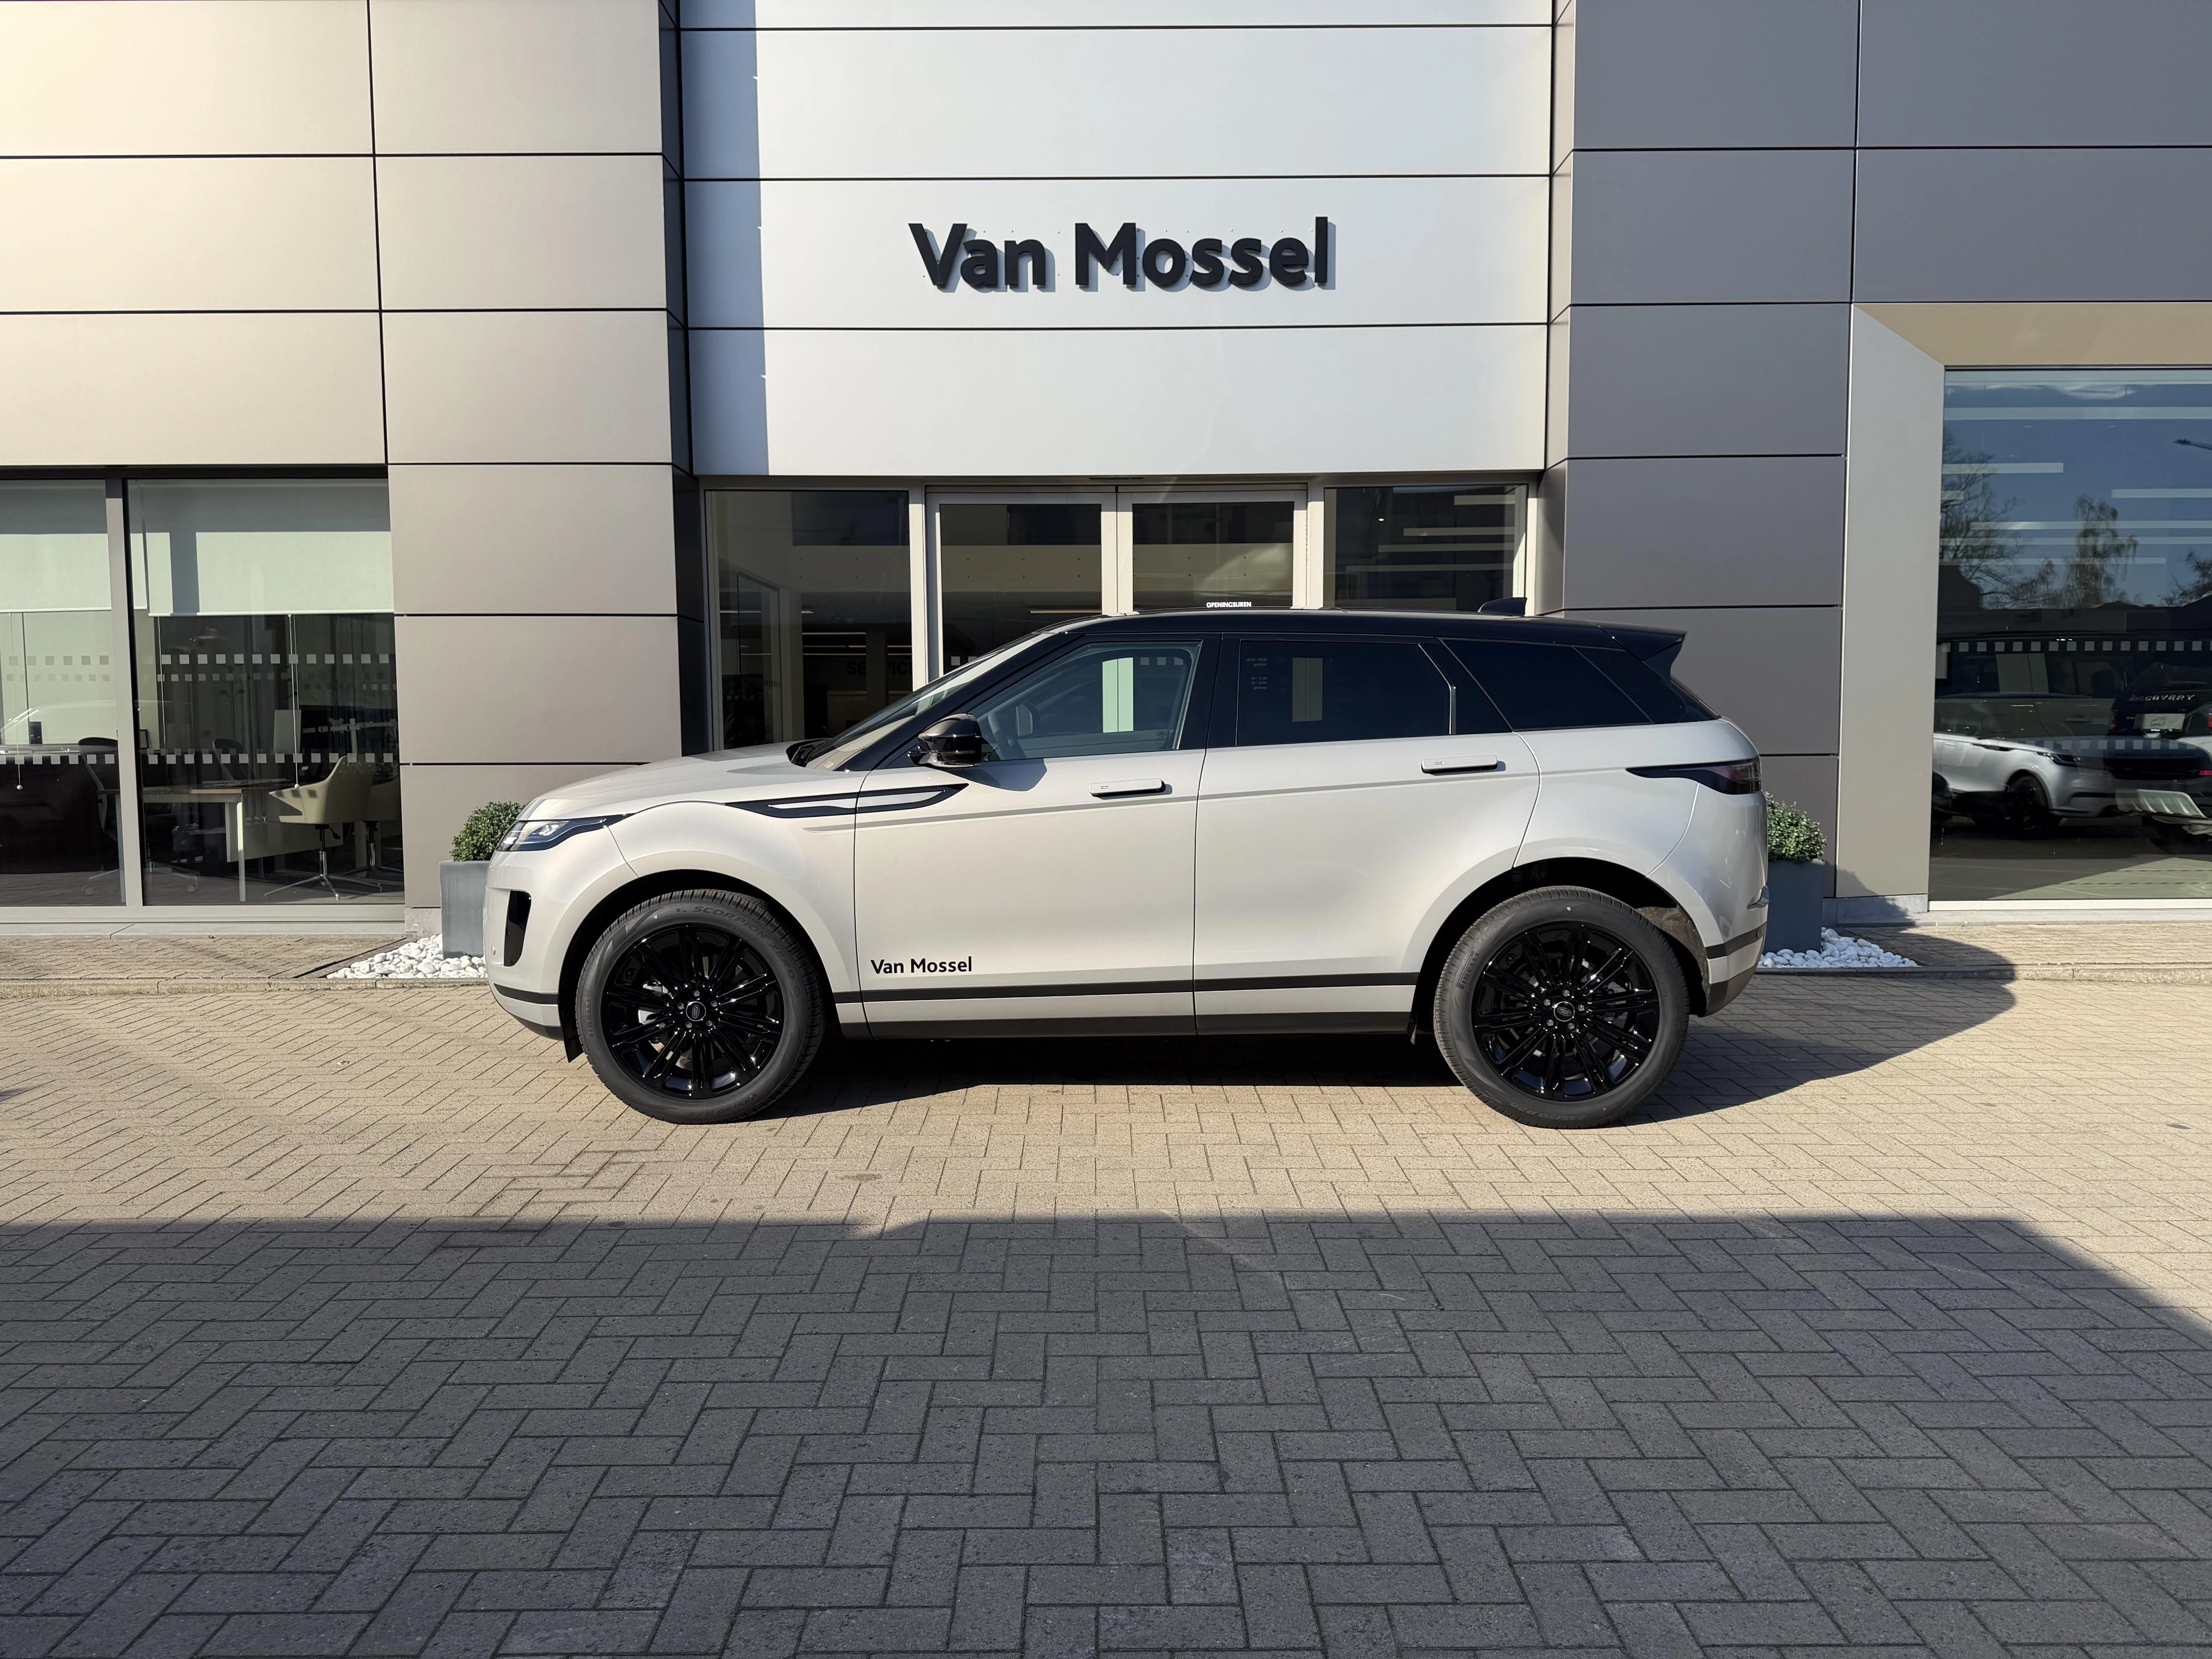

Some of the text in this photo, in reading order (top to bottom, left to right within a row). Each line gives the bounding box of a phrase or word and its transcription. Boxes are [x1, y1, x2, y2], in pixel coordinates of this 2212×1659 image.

[908, 216, 1328, 287] Van Mossel
[692, 906, 768, 939] SCORPION
[768, 942, 795, 979] ZERO
[870, 956, 972, 974] Van Mossel
[585, 999, 594, 1038] PIRELLI
